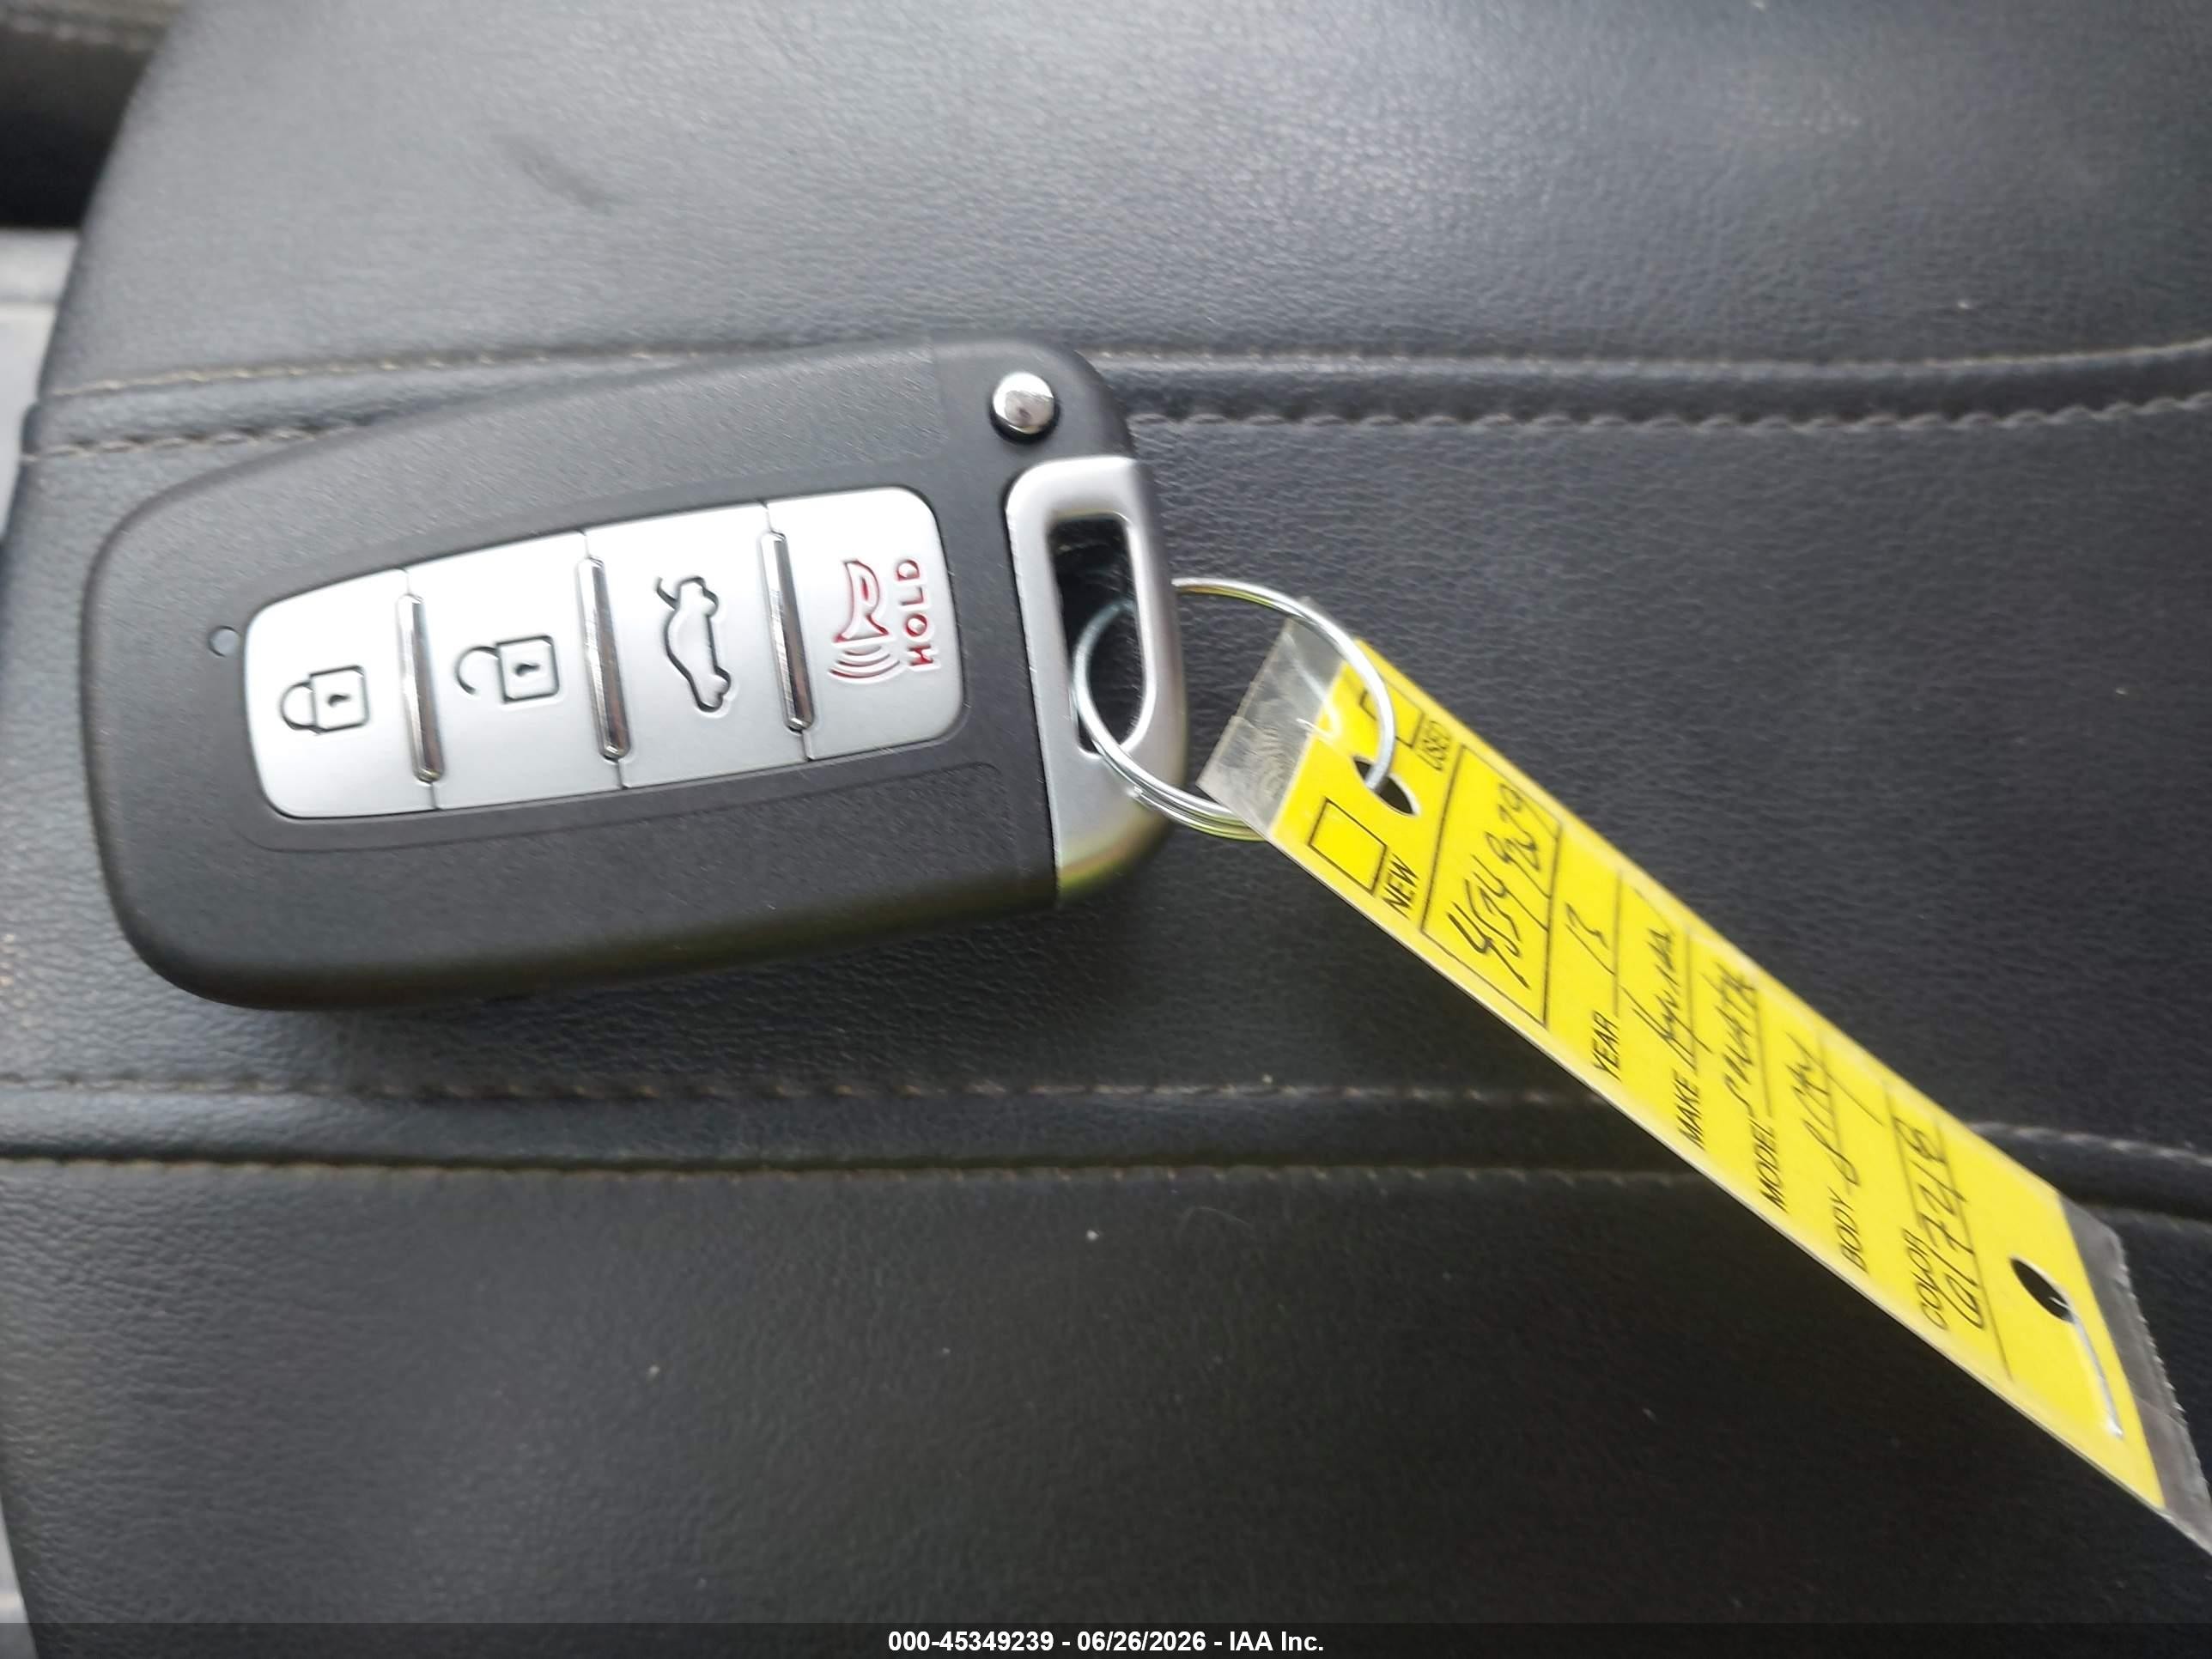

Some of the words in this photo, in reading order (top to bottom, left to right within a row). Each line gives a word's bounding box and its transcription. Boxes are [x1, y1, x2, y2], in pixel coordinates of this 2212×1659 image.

[896, 559, 933, 666] HOLD
[1382, 853, 1419, 920] NEW
[1565, 902, 1616, 976] 13
[1590, 1009, 1621, 1081] YEAR
[1672, 1069, 1705, 1152] MAKE
[1748, 1118, 1789, 1212] MODEL
[1826, 1185, 1869, 1274] BODY
[1902, 1227, 1949, 1331] COLOR
